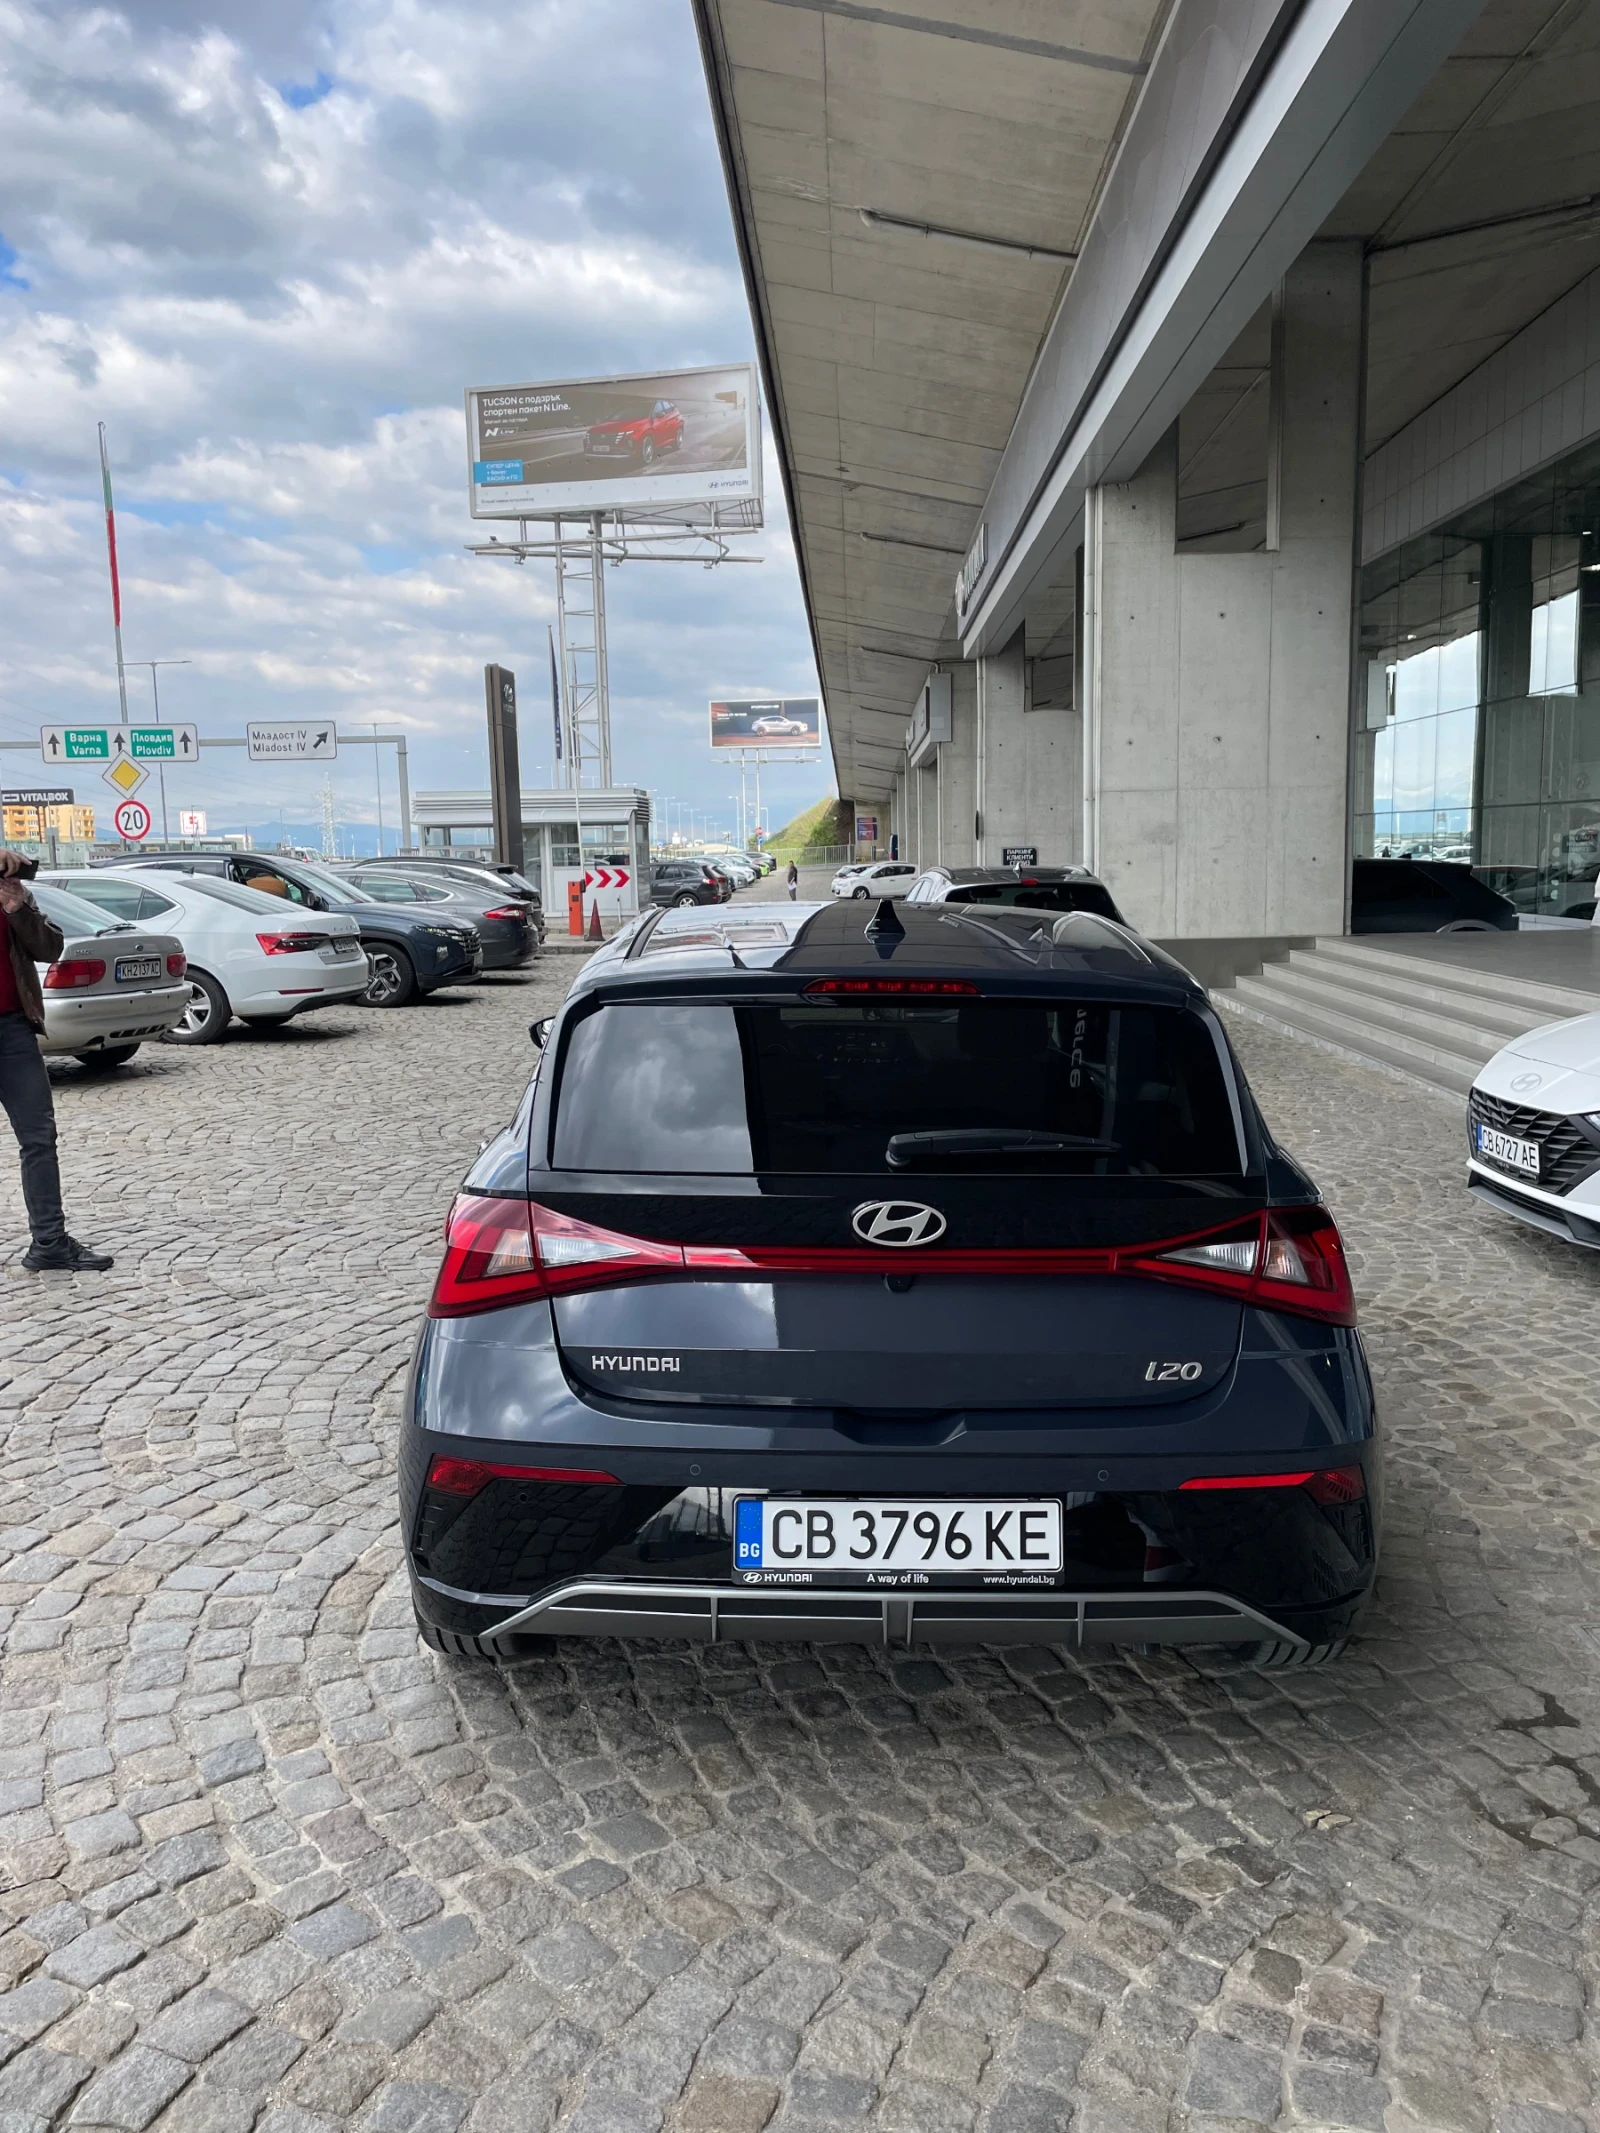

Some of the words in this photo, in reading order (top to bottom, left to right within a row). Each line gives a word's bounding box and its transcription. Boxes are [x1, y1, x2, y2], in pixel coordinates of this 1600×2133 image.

[483, 396, 517, 407] TUCSON
[525, 394, 561, 404] подарък
[483, 407, 518, 417] спортен
[519, 405, 542, 414] пакет
[544, 403, 550, 412] N
[552, 402, 571, 411] Line.
[70, 733, 102, 744] Варна
[132, 732, 173, 743] Пловдив
[252, 731, 295, 741] Младост
[297, 730, 307, 739] IV
[72, 745, 102, 755] Varna
[136, 745, 171, 755] Plovdiv
[253, 743, 292, 752] Mladost
[297, 742, 306, 751] IV
[20, 792, 69, 802] VITALBOX
[121, 809, 144, 831] 20
[1482, 1129, 1494, 1152] CB
[1495, 1134, 1518, 1162] 6727
[1521, 1145, 1538, 1169] AE
[591, 1355, 680, 1372] HYUNDAI
[771, 1509, 836, 1559] CB
[849, 1510, 973, 1560] 3796
[985, 1510, 1050, 1560] KE
[738, 1542, 760, 1558] BG
[764, 1573, 813, 1583] HYUNDAI
[866, 1574, 876, 1583] A
[877, 1575, 898, 1585] way
[900, 1574, 912, 1583] of
[913, 1574, 930, 1584] life
[983, 1575, 1055, 1586] www.hyundai.bg
